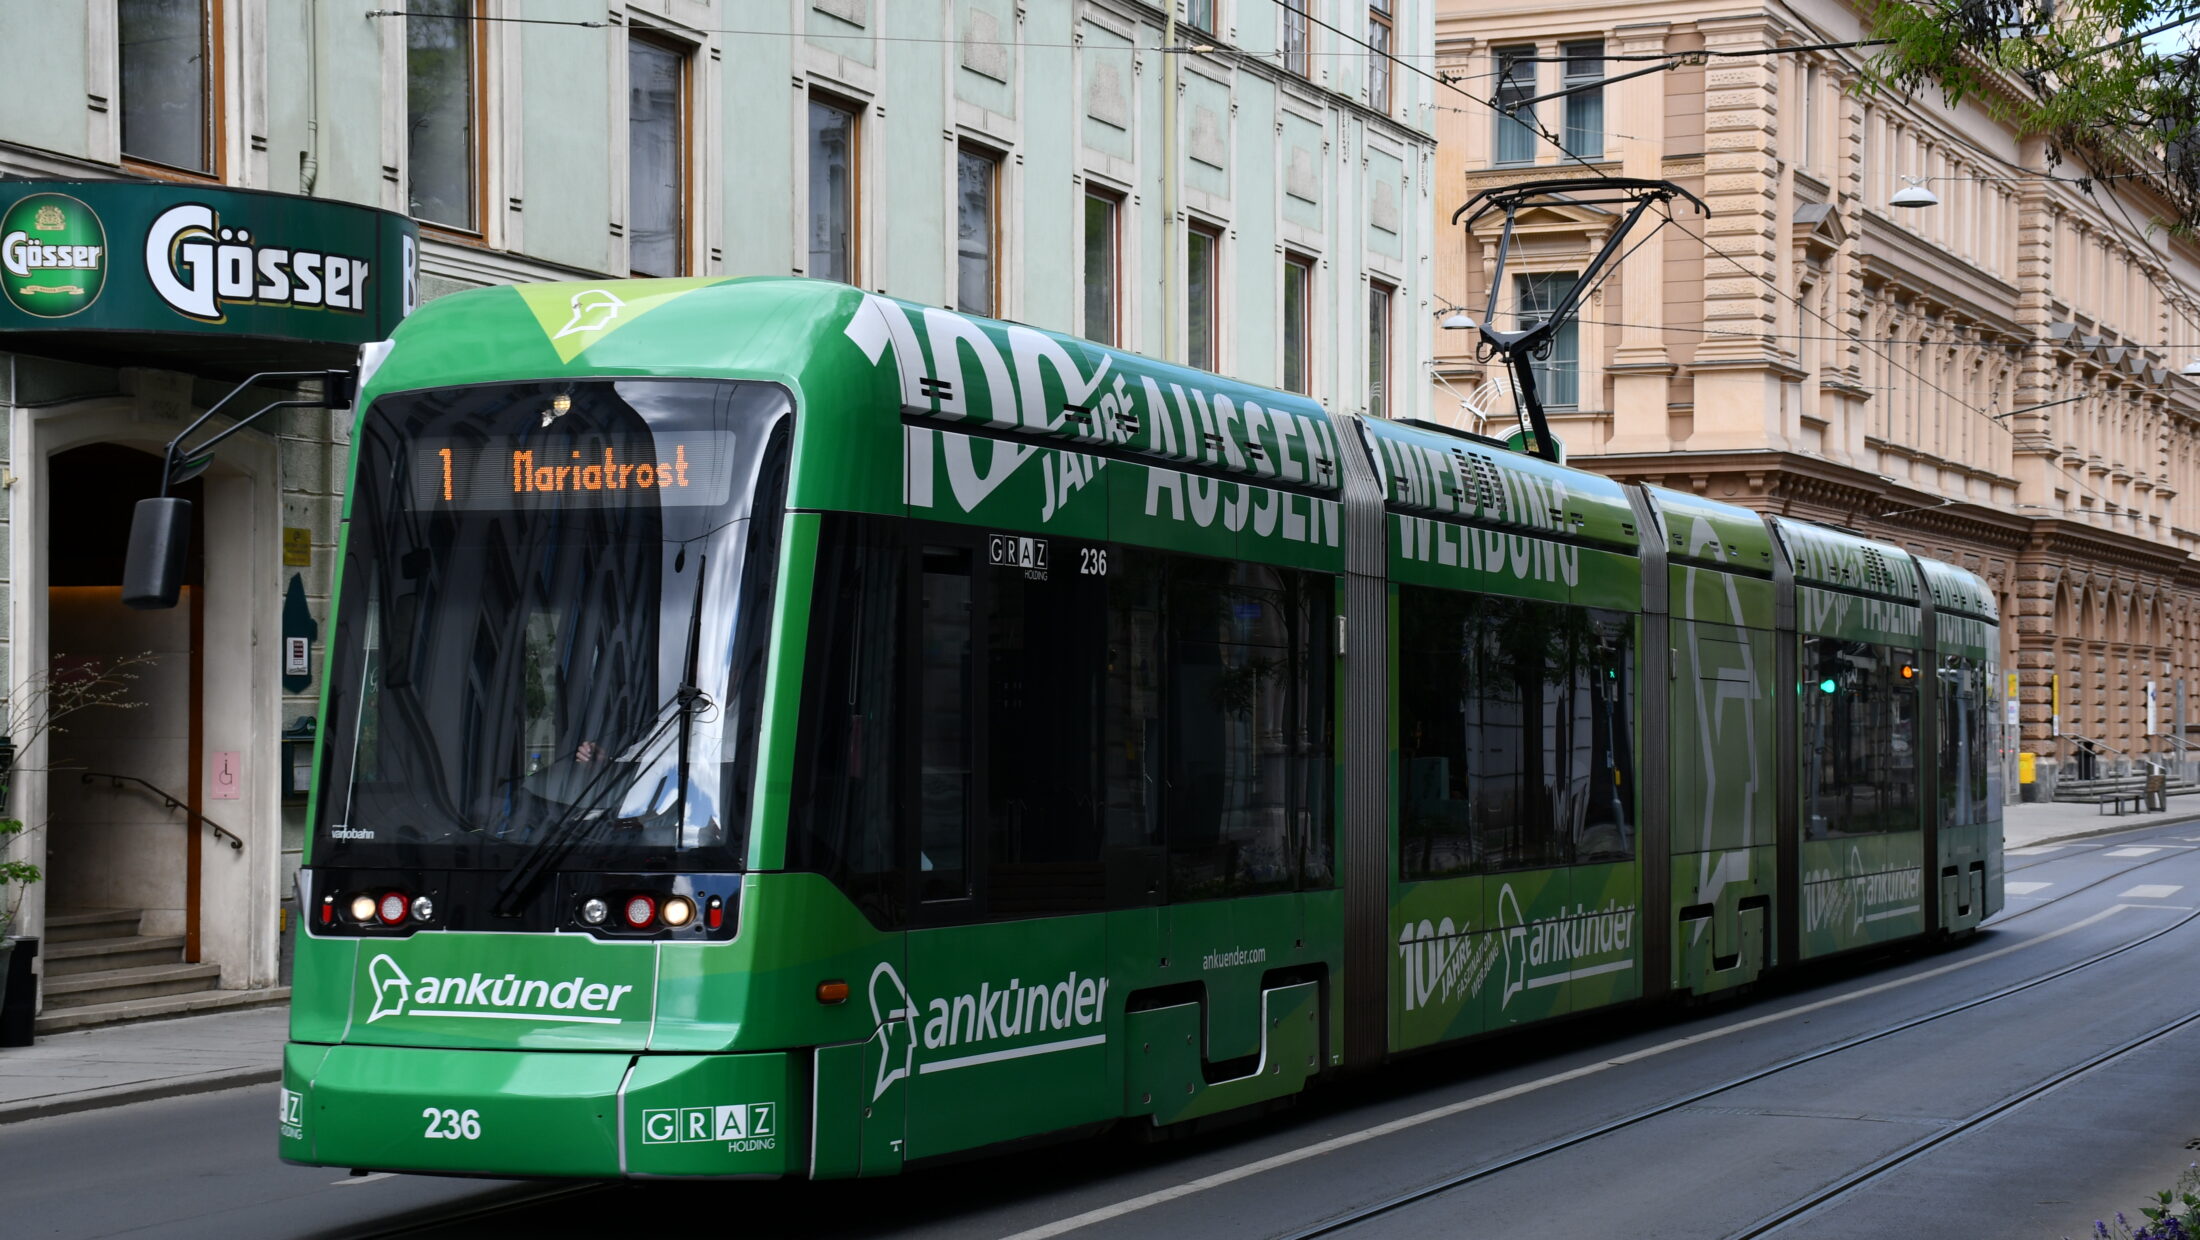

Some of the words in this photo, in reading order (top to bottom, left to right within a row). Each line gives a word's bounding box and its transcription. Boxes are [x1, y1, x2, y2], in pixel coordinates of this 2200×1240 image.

[2, 231, 101, 276] Gösser
[146, 204, 369, 320] Gösser
[844, 293, 1113, 513] 100
[1042, 373, 1140, 523] JAHRE
[1140, 375, 1340, 548] AUSSEN
[1382, 436, 1579, 588] WERBUNG
[439, 448, 452, 500] 1
[513, 445, 689, 492] Mariatrost
[989, 534, 1048, 569] GRAZ
[1080, 548, 1107, 576] 236
[1024, 569, 1048, 581] HOLDING
[332, 827, 375, 839] variobahn
[1529, 898, 1636, 967] ankünder
[1203, 945, 1266, 970] ankuender.com
[1399, 917, 1469, 1011] 100
[1441, 930, 1473, 1004] JAHRE
[415, 972, 633, 1012] ankünder
[923, 970, 1109, 1050] ankünder
[422, 1107, 482, 1140] 236
[642, 1102, 775, 1144] GRAZ
[728, 1138, 775, 1153] HOLDING
